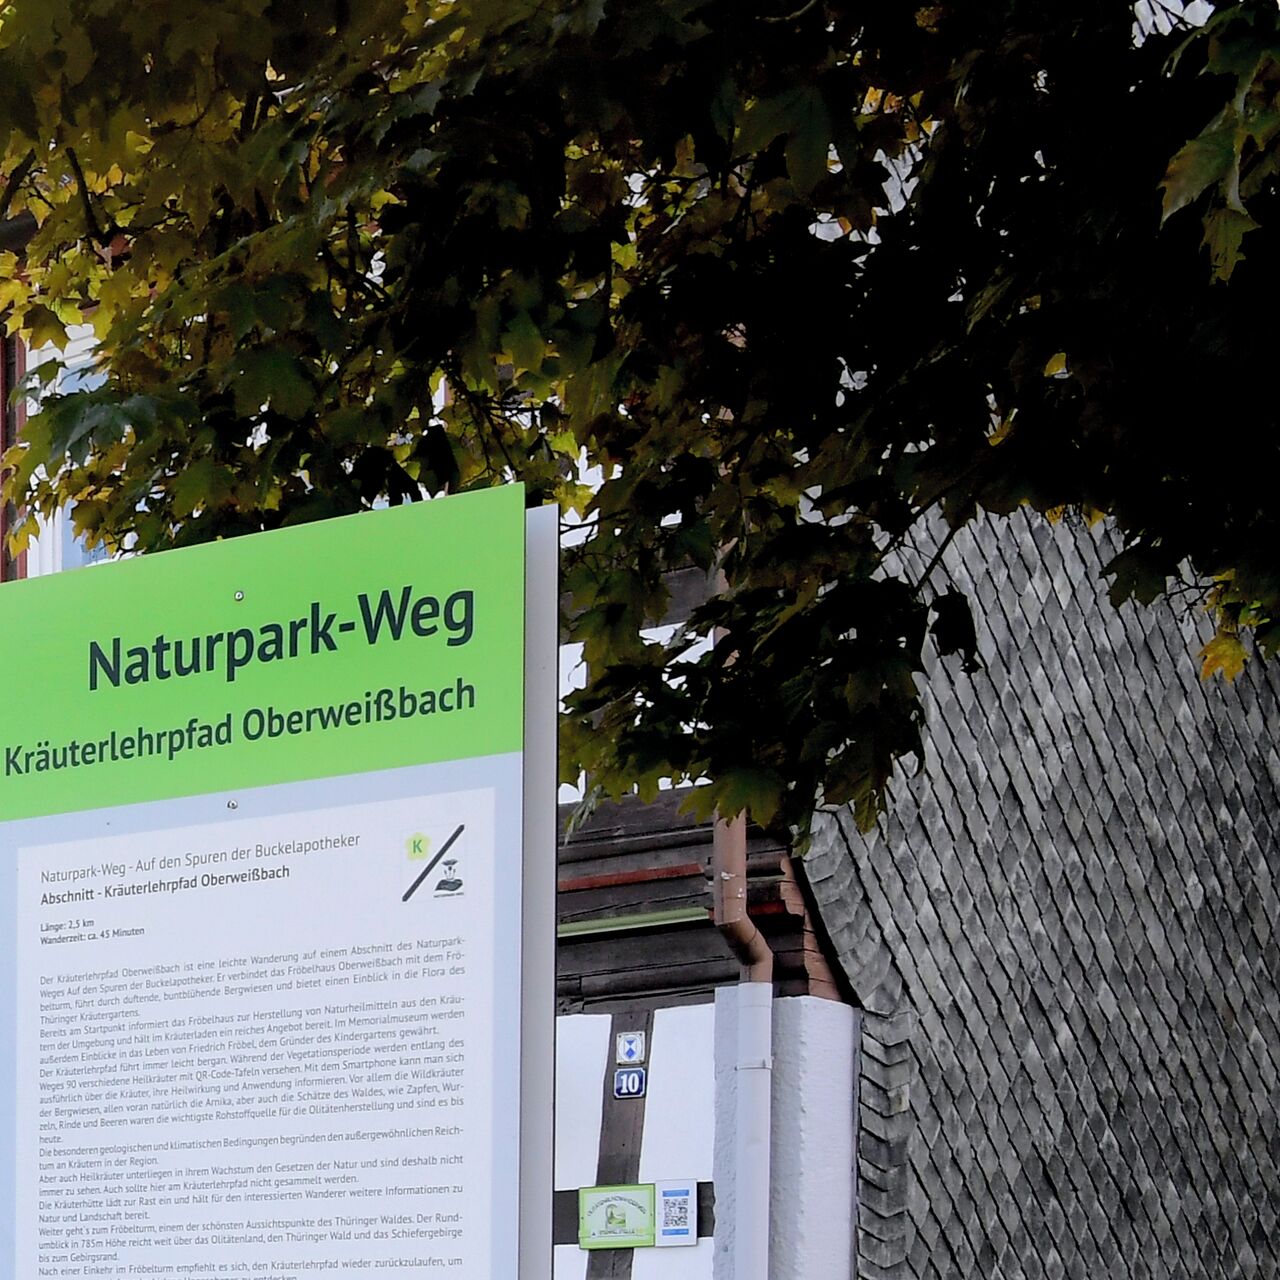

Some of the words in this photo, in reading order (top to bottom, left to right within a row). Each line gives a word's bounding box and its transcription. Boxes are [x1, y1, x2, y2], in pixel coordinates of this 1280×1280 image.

[89, 585, 474, 691] Naturpark-Weg
[5, 713, 232, 777] Kräuterlehrpfad
[243, 677, 475, 741] Oberweißbach
[40, 862, 126, 884] Naturpark-Weg
[135, 856, 157, 873] Auf
[158, 856, 182, 870] den
[184, 851, 228, 869] Spuren
[231, 847, 252, 861] der
[255, 834, 361, 858] Buckelapotheker
[411, 838, 423, 855] K
[40, 888, 95, 906] Abschnitt
[104, 875, 198, 898] Kräuterlehrpfad
[200, 864, 290, 888] Oberweißbach
[39, 932, 87, 945] Wanderzeit:
[87, 933, 99, 941] ca.
[99, 929, 111, 939] 45
[111, 927, 145, 938] Minuten
[40, 922, 67, 933] Länge:
[68, 919, 81, 930] 2,5
[82, 918, 95, 928] km
[39, 975, 54, 986] Der
[56, 969, 119, 984] Kräuterlehrpfad
[121, 963, 181, 978] Oberweißbach
[183, 962, 194, 972] ist
[196, 960, 216, 971] eine
[218, 957, 248, 969] leichte
[250, 951, 299, 965] Wanderung
[302, 949, 317, 960] auf
[320, 948, 348, 959] einem
[350, 943, 393, 956] Abschnitt
[396, 940, 413, 952] des
[416, 935, 465, 949] Naturpark-
[39, 989, 65, 1000] Weges
[66, 985, 81, 996] Auf
[82, 984, 98, 995] den
[99, 983, 128, 995] Spuren
[129, 981, 144, 991] der
[145, 974, 216, 989] Buckelapotheker.
[216, 972, 226, 983] Er
[226, 968, 269, 981] verbindet
[270, 967, 286, 978] das
[287, 963, 336, 976] Fröbelhaus
[337, 956, 403, 972] Oberweißbach
[405, 954, 421, 965] mit
[422, 953, 444, 964] dem
[446, 950, 465, 961] Frö-
[619, 1072, 640, 1095] 10
[38, 1266, 59, 1277] Nach
[60, 1266, 81, 1276] einer
[82, 1265, 114, 1276] Einkehr
[115, 1265, 127, 1274] im
[128, 1263, 174, 1274] Fröbelturm
[175, 1262, 216, 1275] empfiehlt
[218, 1263, 228, 1272] es
[230, 1261, 251, 1272] sich,
[251, 1261, 269, 1271] den
[270, 1258, 339, 1272] Kräuterlehrpfad
[341, 1258, 372, 1269] wieder
[374, 1256, 446, 1268] zurückzulaufen,
[447, 1258, 463, 1266] um
